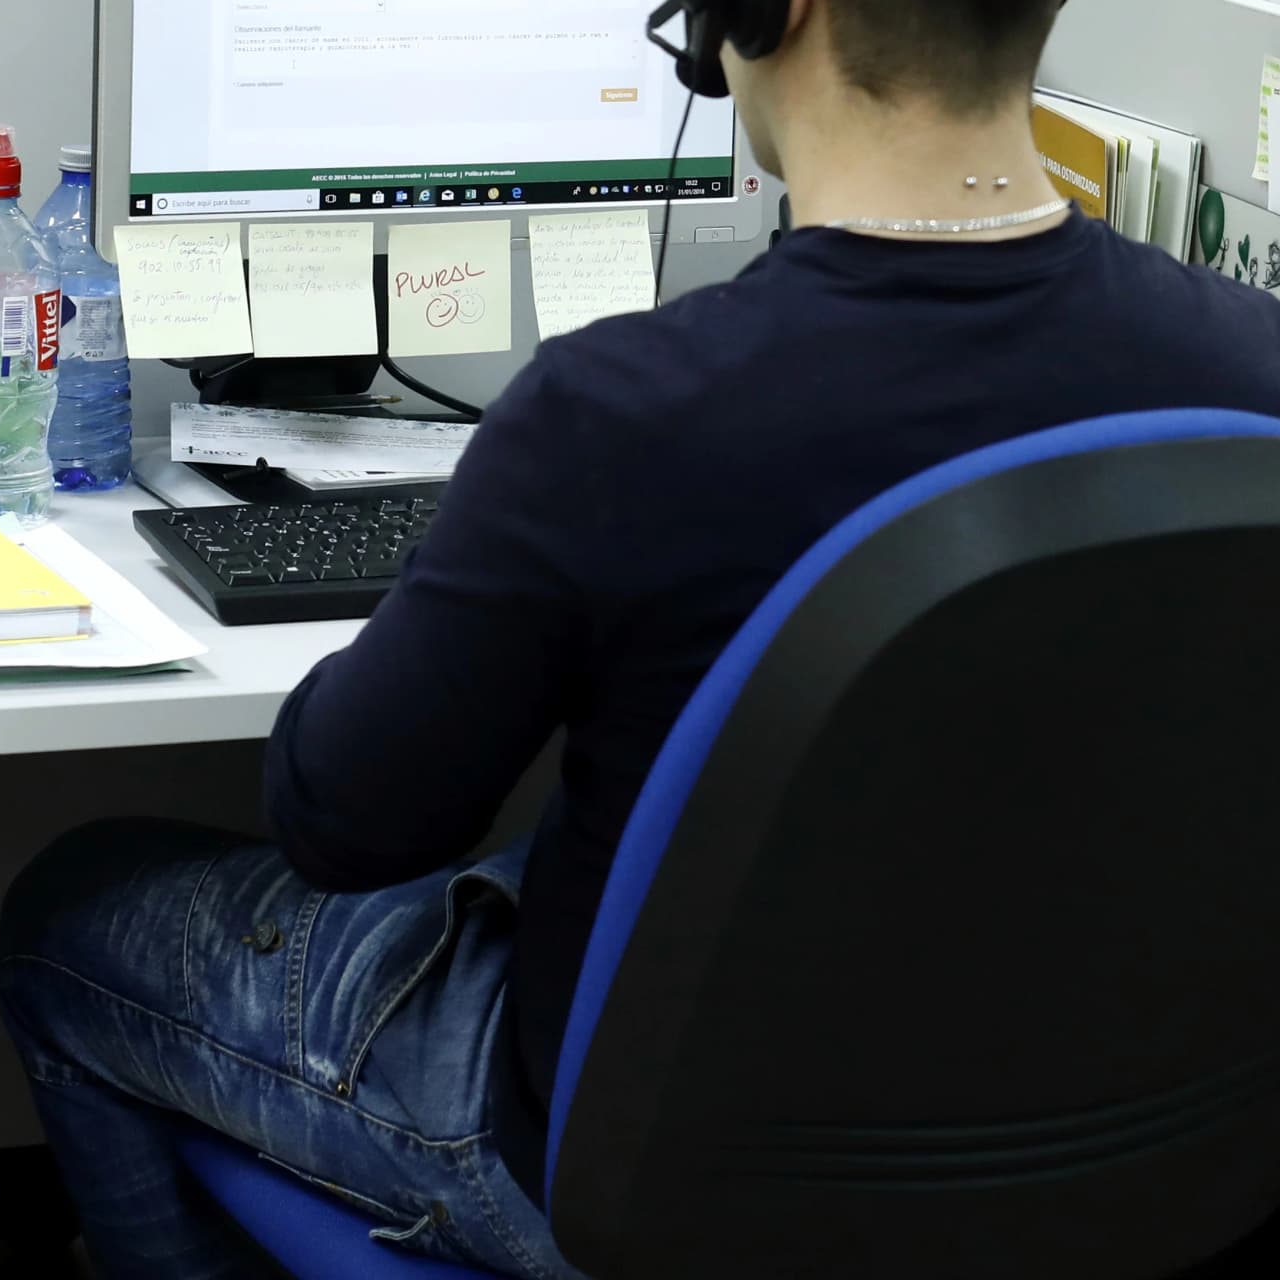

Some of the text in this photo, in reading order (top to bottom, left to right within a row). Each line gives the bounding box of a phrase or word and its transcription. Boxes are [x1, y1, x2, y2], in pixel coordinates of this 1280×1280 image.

[1047, 157, 1100, 199] PARA OSTOMIZADOS
[172, 198, 251, 209] Escribe aquí para buscar
[395, 261, 485, 297] PLURAL
[41, 293, 57, 362] Vittel
